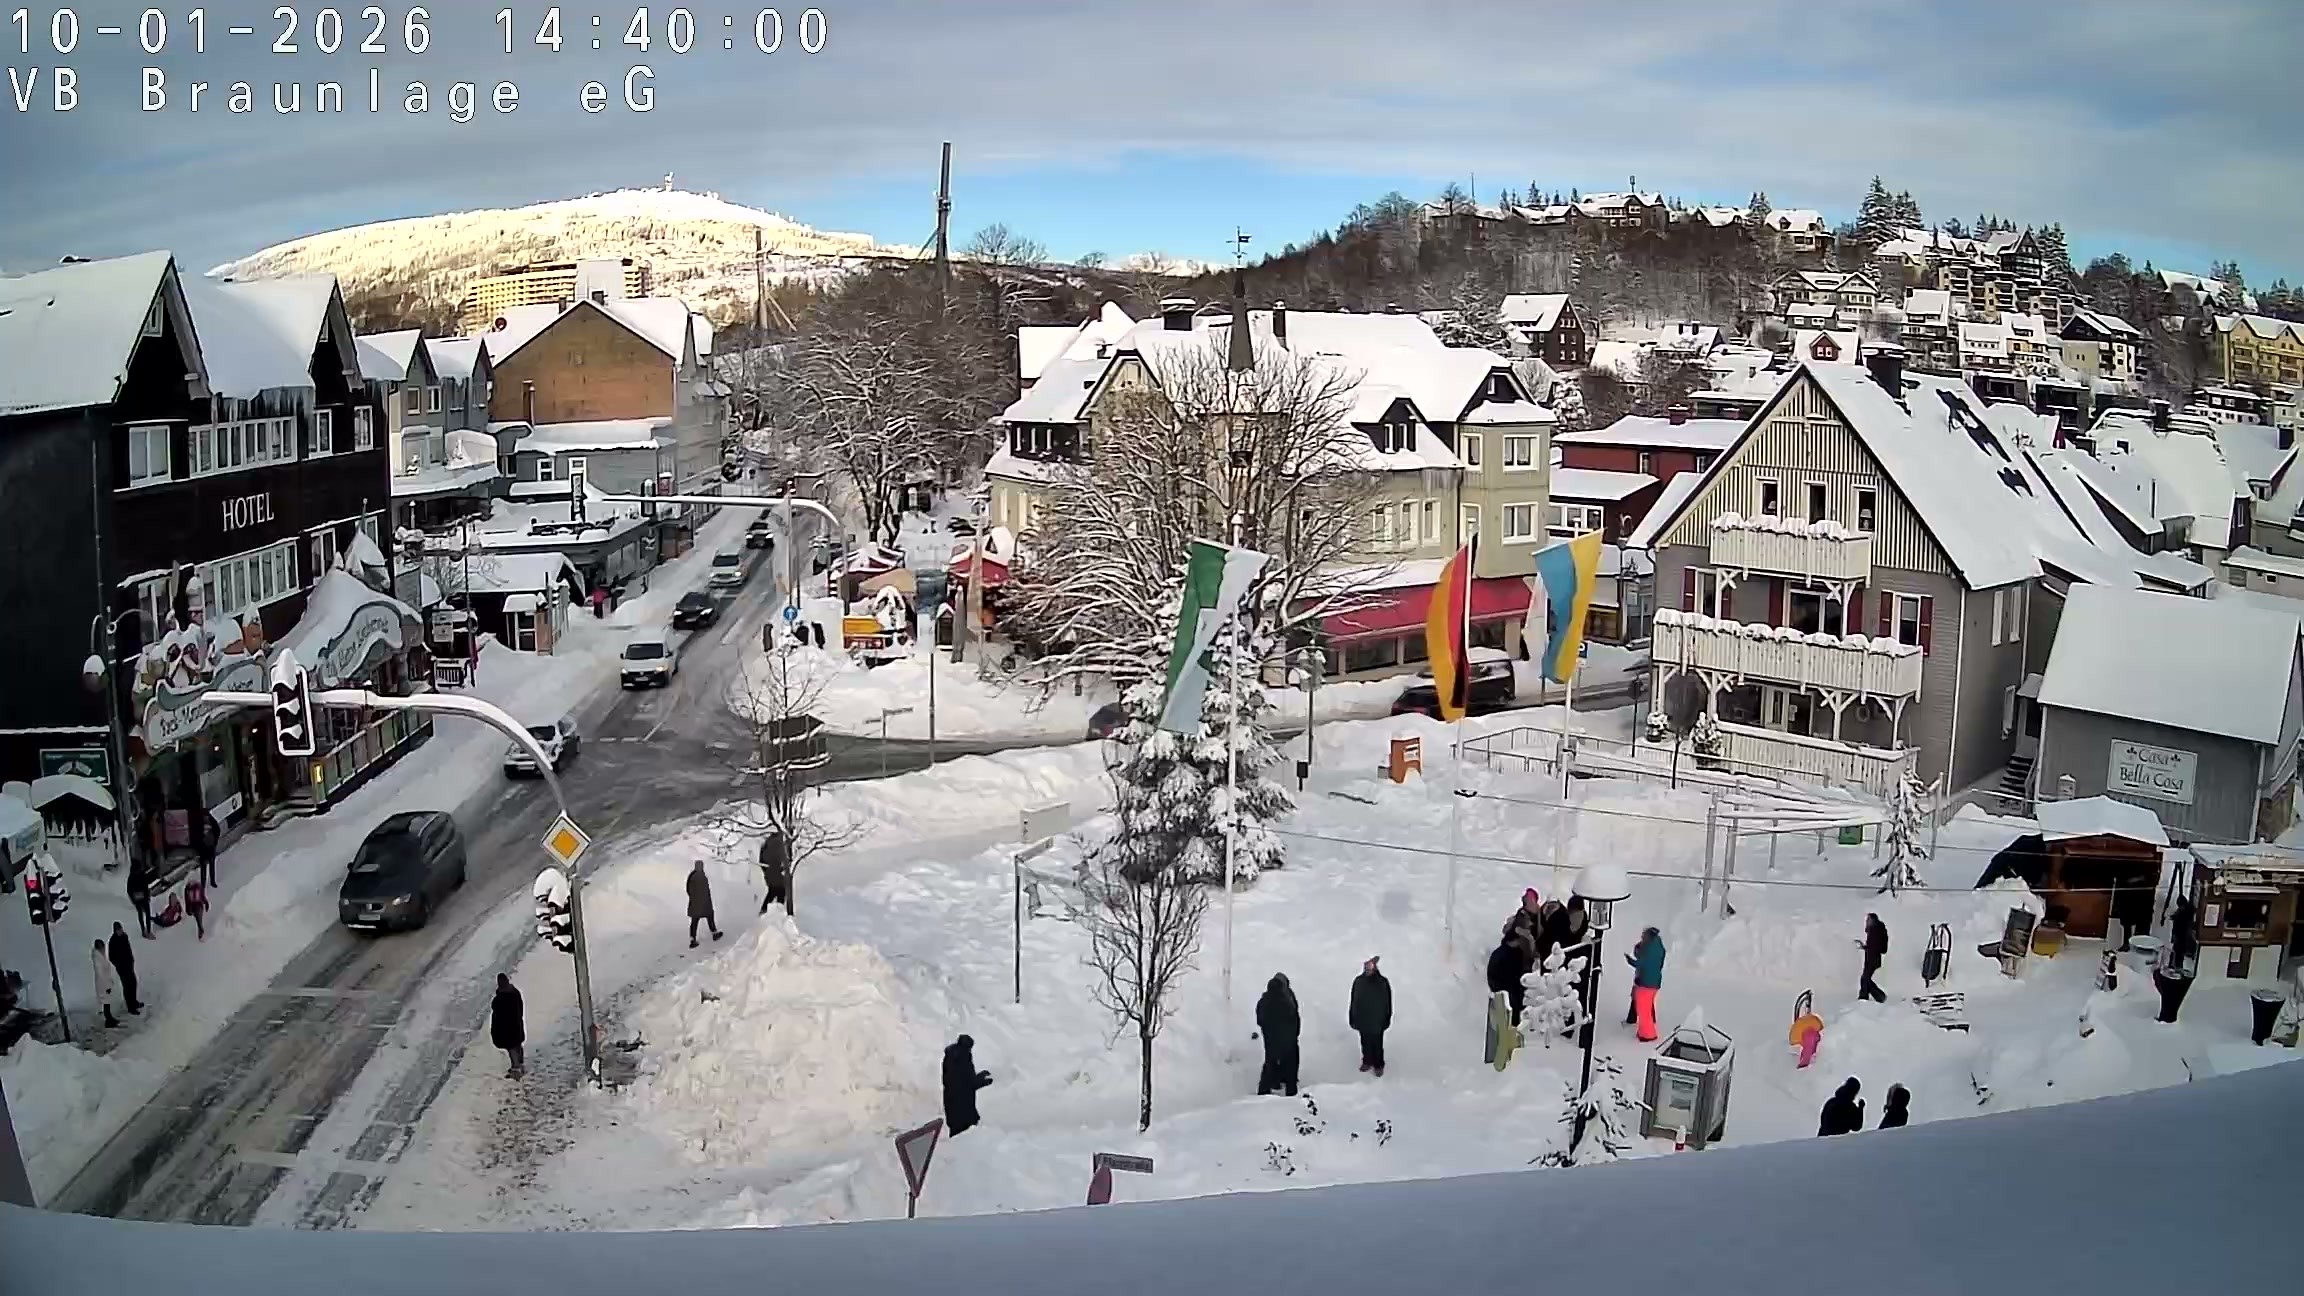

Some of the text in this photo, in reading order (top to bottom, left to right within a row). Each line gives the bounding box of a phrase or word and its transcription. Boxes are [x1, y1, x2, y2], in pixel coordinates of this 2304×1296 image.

[221, 491, 275, 532] HOTEL
[2139, 749, 2168, 765] Casa
[2120, 764, 2149, 784] Bella
